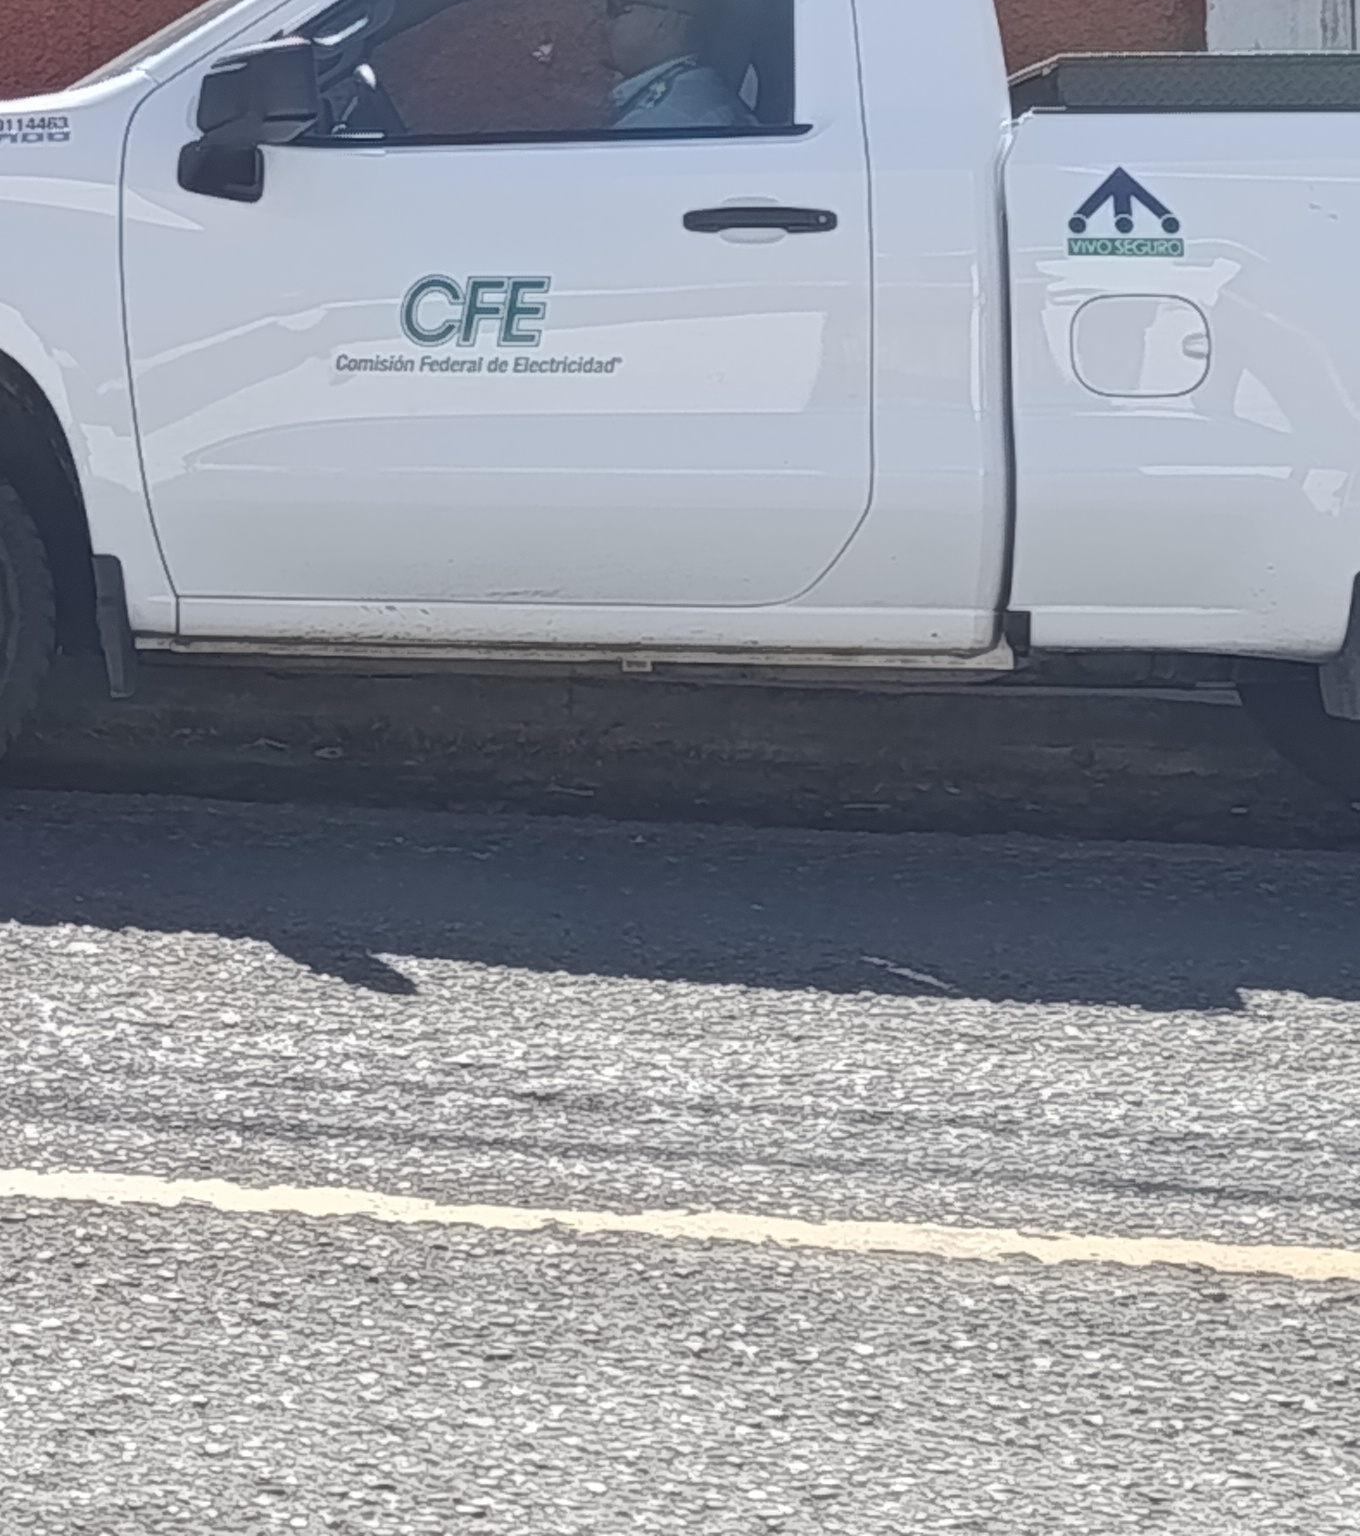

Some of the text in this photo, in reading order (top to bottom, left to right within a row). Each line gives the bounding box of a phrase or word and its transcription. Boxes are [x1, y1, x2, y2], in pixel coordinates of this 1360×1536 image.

[1070, 239, 1181, 255] VIVO SEGURO
[401, 274, 551, 347] CFE
[336, 354, 414, 372] Comisión
[420, 356, 483, 373] Federal
[487, 357, 508, 373] de
